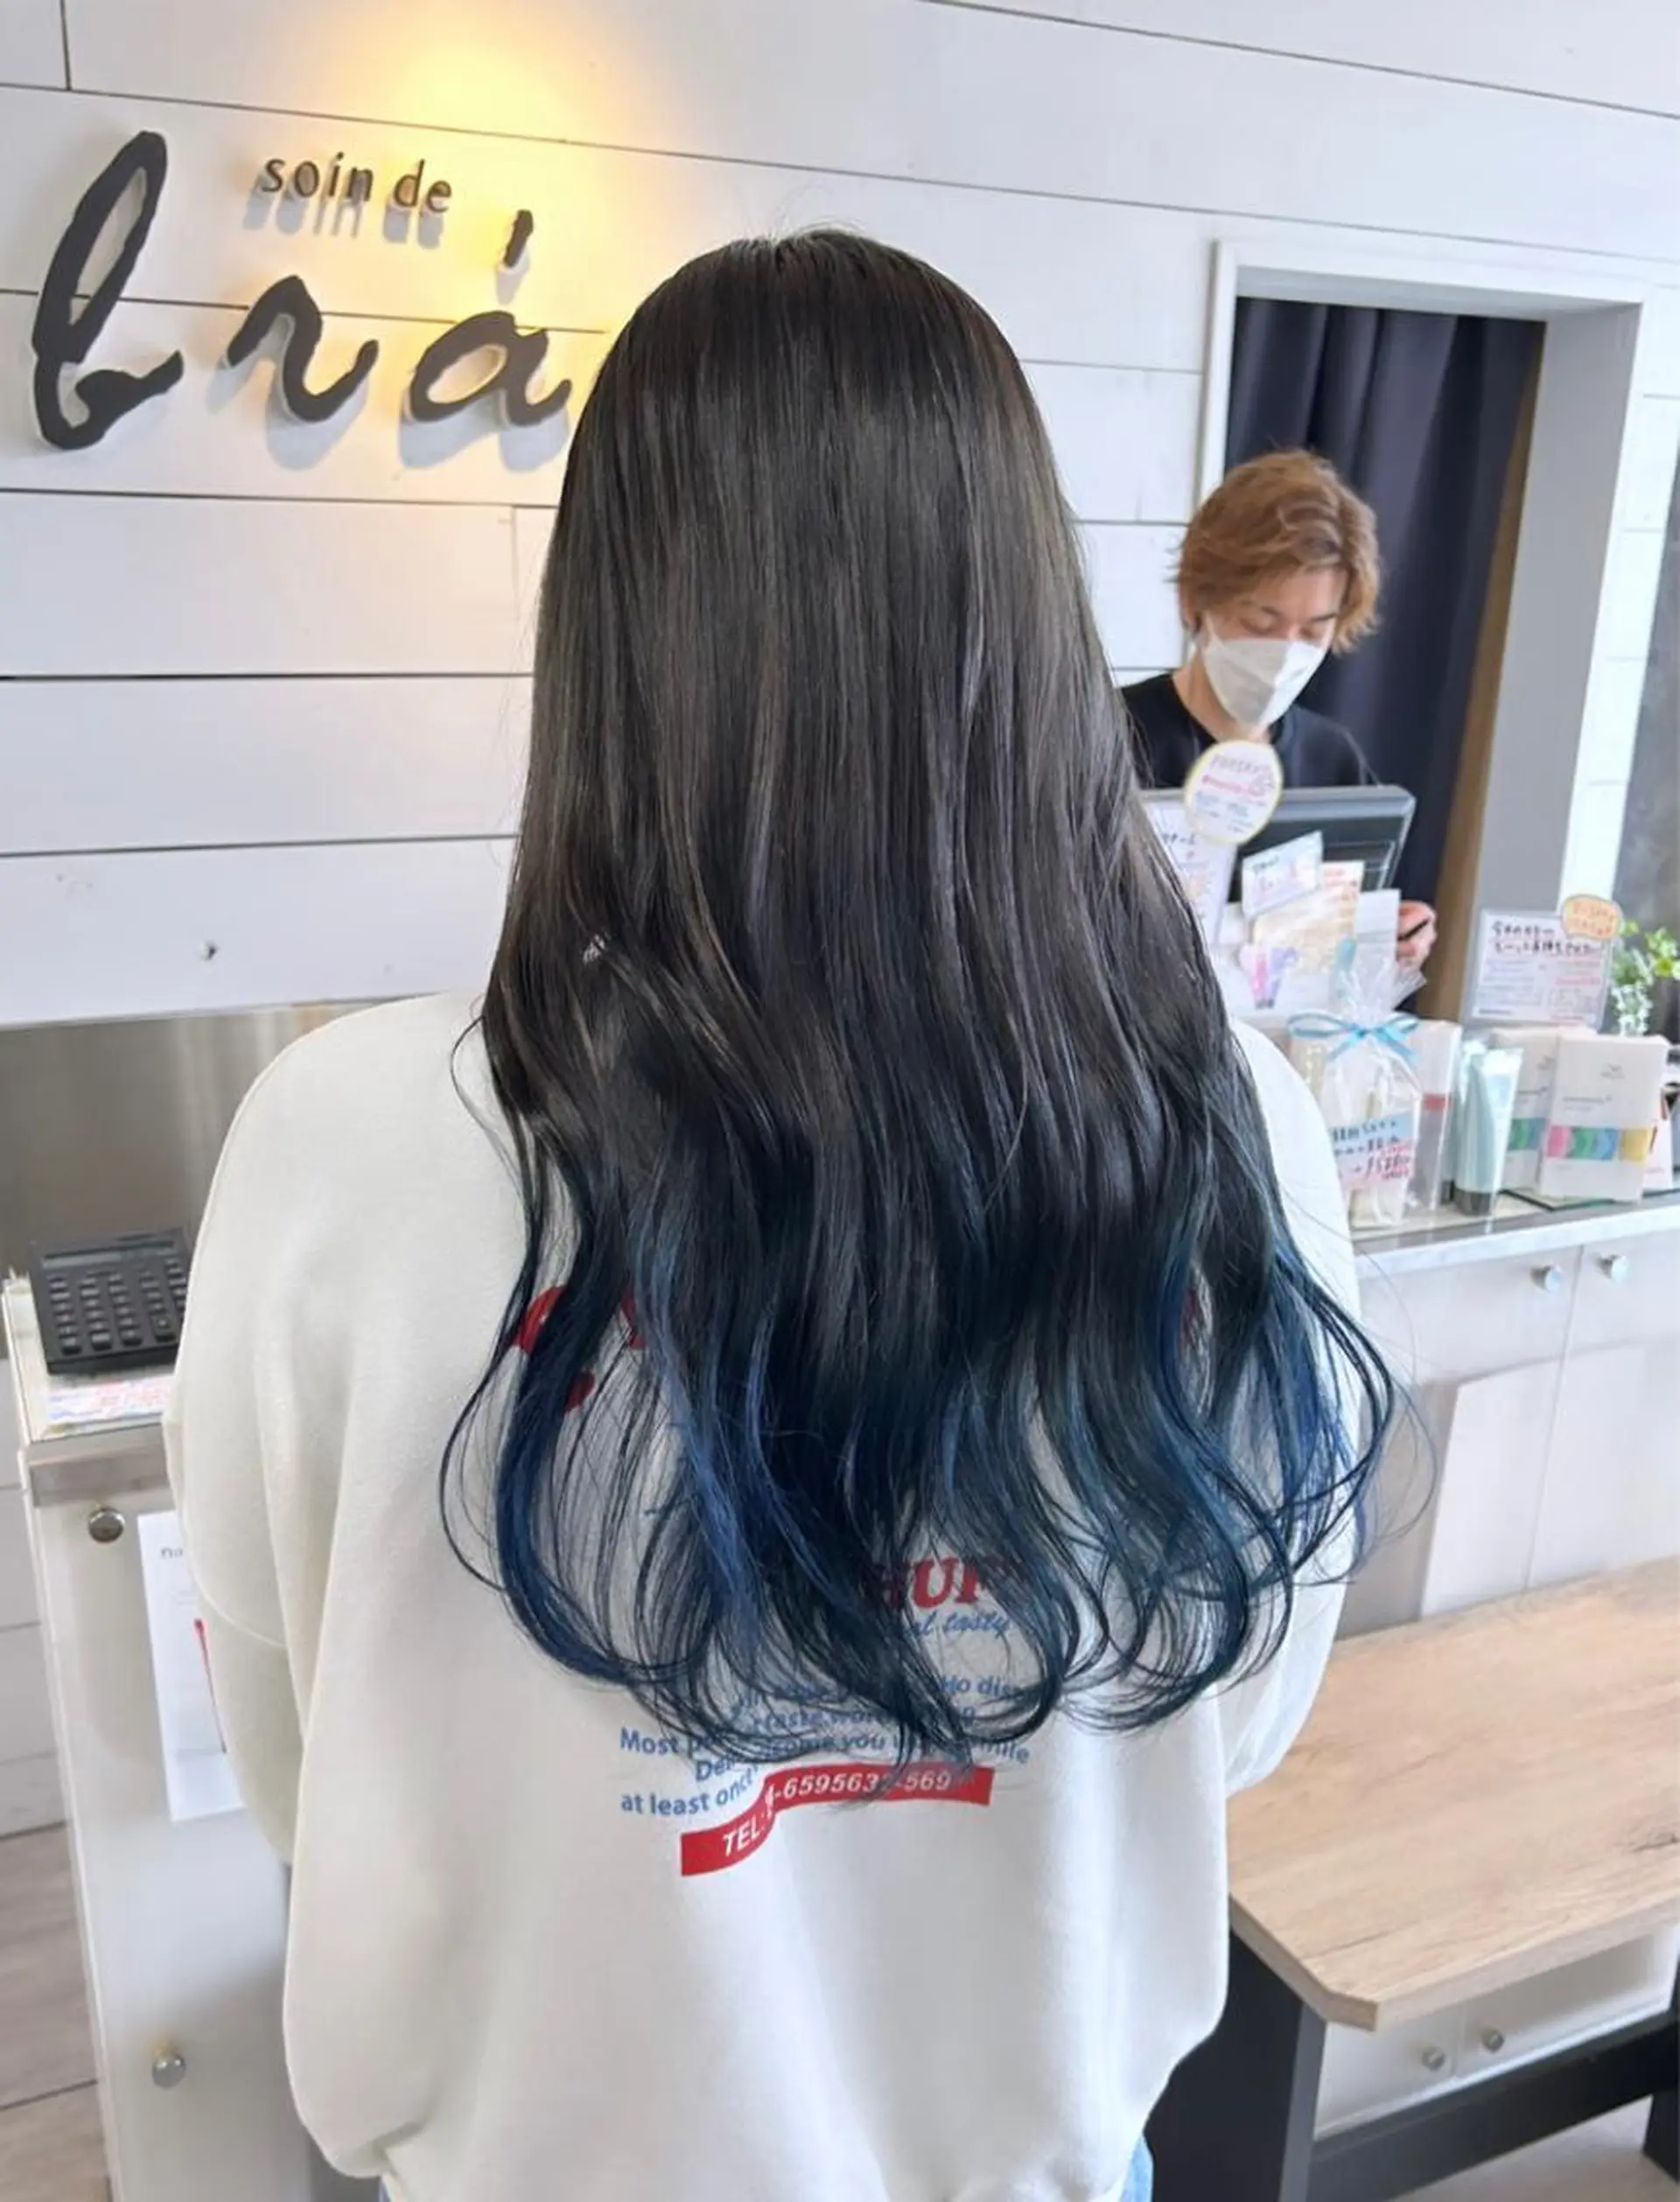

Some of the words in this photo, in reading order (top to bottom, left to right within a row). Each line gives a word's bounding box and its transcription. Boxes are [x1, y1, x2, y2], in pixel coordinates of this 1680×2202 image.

[263, 152, 373, 201] soin
[393, 159, 452, 214] de
[620, 1728, 679, 1755] Most
[621, 1795, 643, 1814] at
[650, 1793, 710, 1816] least
